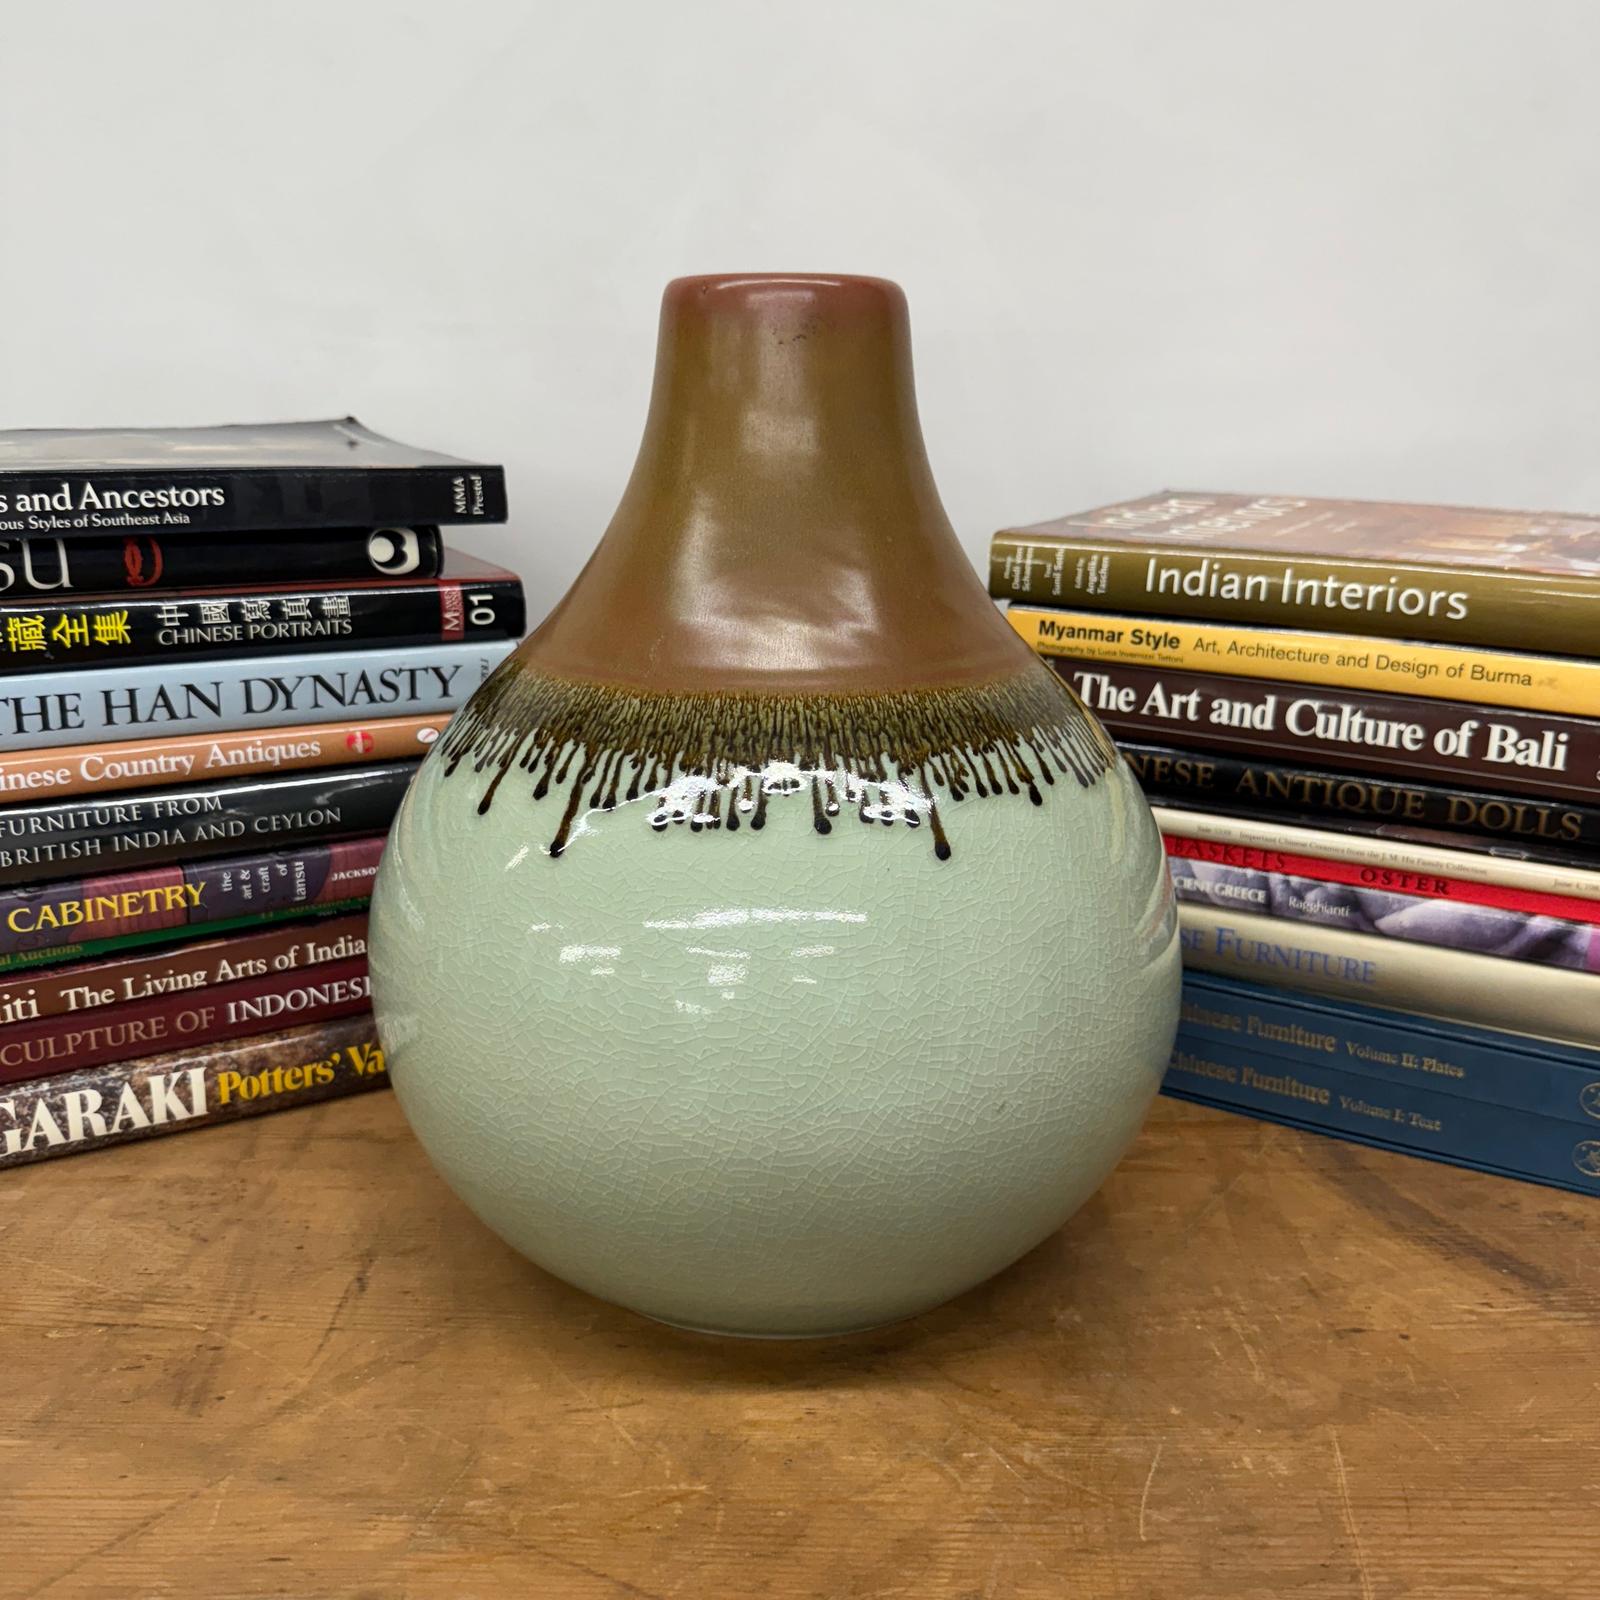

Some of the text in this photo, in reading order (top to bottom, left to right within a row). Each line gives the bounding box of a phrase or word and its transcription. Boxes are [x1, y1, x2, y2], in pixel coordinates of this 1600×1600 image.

[16, 482, 73, 512] and
[79, 481, 225, 510] Ancestors
[453, 476, 467, 514] MMA
[469, 474, 484, 515] Prestel
[28, 515, 71, 532] Styles
[74, 514, 89, 528] of
[92, 512, 160, 527] Southeast
[163, 510, 190, 525] Asia
[467, 594, 496, 626] 01
[1146, 558, 1468, 620] Indian Interiors
[0, 610, 131, 653] 藏全集
[158, 618, 353, 646] CHINESE PORTRAITS
[1039, 620, 1533, 687] Myanmar Style Art, Architecture and Design of Burma
[100, 681, 223, 727] HAN
[240, 664, 463, 715] DYNASTY
[1073, 671, 1137, 713] The
[1139, 681, 1202, 721] Art
[1209, 694, 1277, 731] and
[1285, 698, 1425, 751] Culture
[1433, 719, 1479, 758] of
[1481, 722, 1570, 771] Bali
[80, 754, 195, 784] Country
[205, 739, 321, 768] Antiques
[151, 796, 223, 819] FROM
[1235, 766, 1426, 819] ANTIQUE
[1446, 795, 1584, 841] DOLLS
[0, 807, 342, 867] BRITISH INDIA AND CEYLON
[221, 871, 233, 893] the
[240, 869, 251, 881] &
[276, 862, 288, 876] of
[331, 866, 379, 881] JACKSO
[1175, 836, 1450, 895] BASKETS OSTER
[7, 881, 207, 933] CABINETRY
[1214, 882, 1266, 904] GREECE
[1288, 896, 1350, 917] Ragghianti
[16, 944, 83, 963] Auctions
[1215, 925, 1377, 984] FURNITURE
[0, 935, 367, 1024] iti The Living Arts of India
[1, 1016, 168, 1066] CULPTURE
[176, 1007, 215, 1033] OF
[1246, 1015, 1337, 1052] Furniture
[1345, 1041, 1398, 1065] Volume
[1401, 1053, 1418, 1069] II:
[1422, 1057, 1465, 1078] Plates
[217, 1052, 341, 1105] Potters'
[346, 1043, 387, 1076] Va
[1241, 1065, 1331, 1105] Furniture
[1339, 1095, 1391, 1120] Volume
[1408, 1112, 1441, 1131] Text
